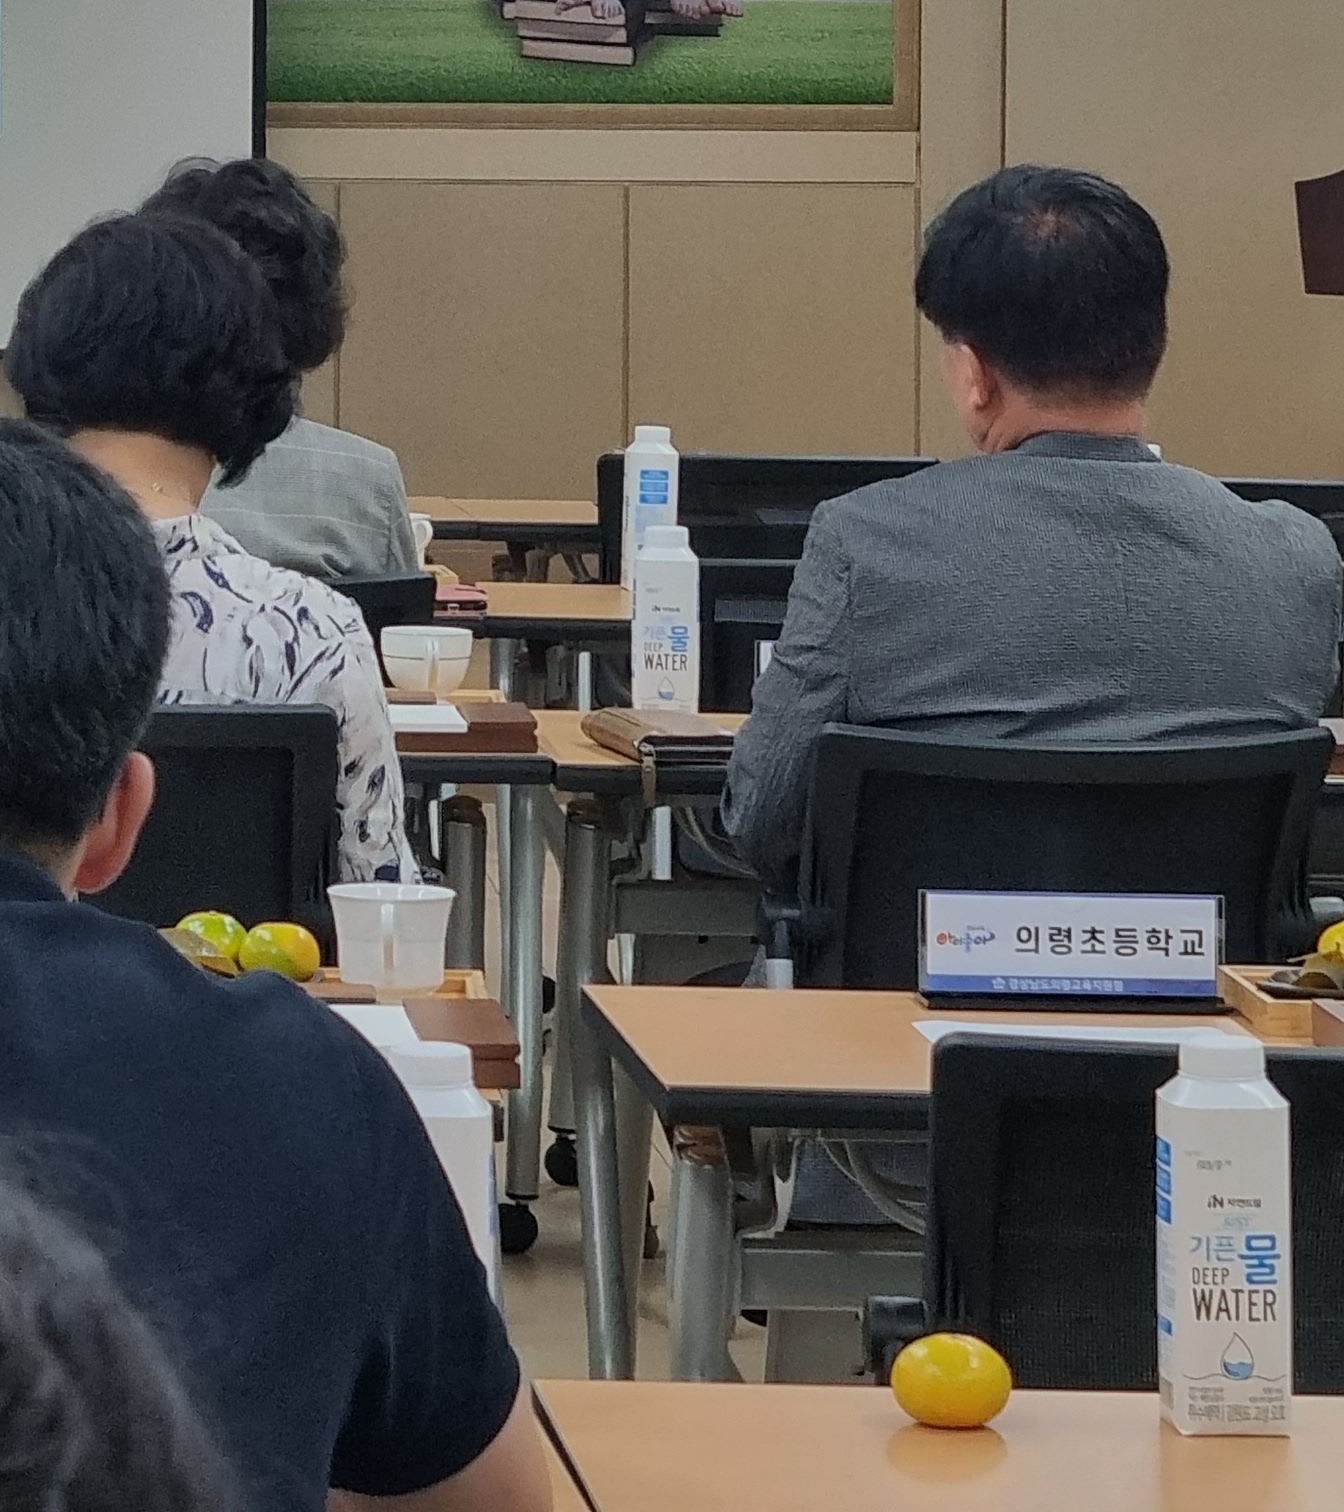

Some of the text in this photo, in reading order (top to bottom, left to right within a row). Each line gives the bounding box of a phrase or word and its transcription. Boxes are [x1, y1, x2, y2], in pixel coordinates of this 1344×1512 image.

[643, 652, 688, 671] WATER
[1014, 925, 1206, 958] 의령초등학교
[1191, 1266, 1230, 1286] DEEP
[1237, 1234, 1281, 1285] 물
[1191, 1288, 1278, 1323] WATER
